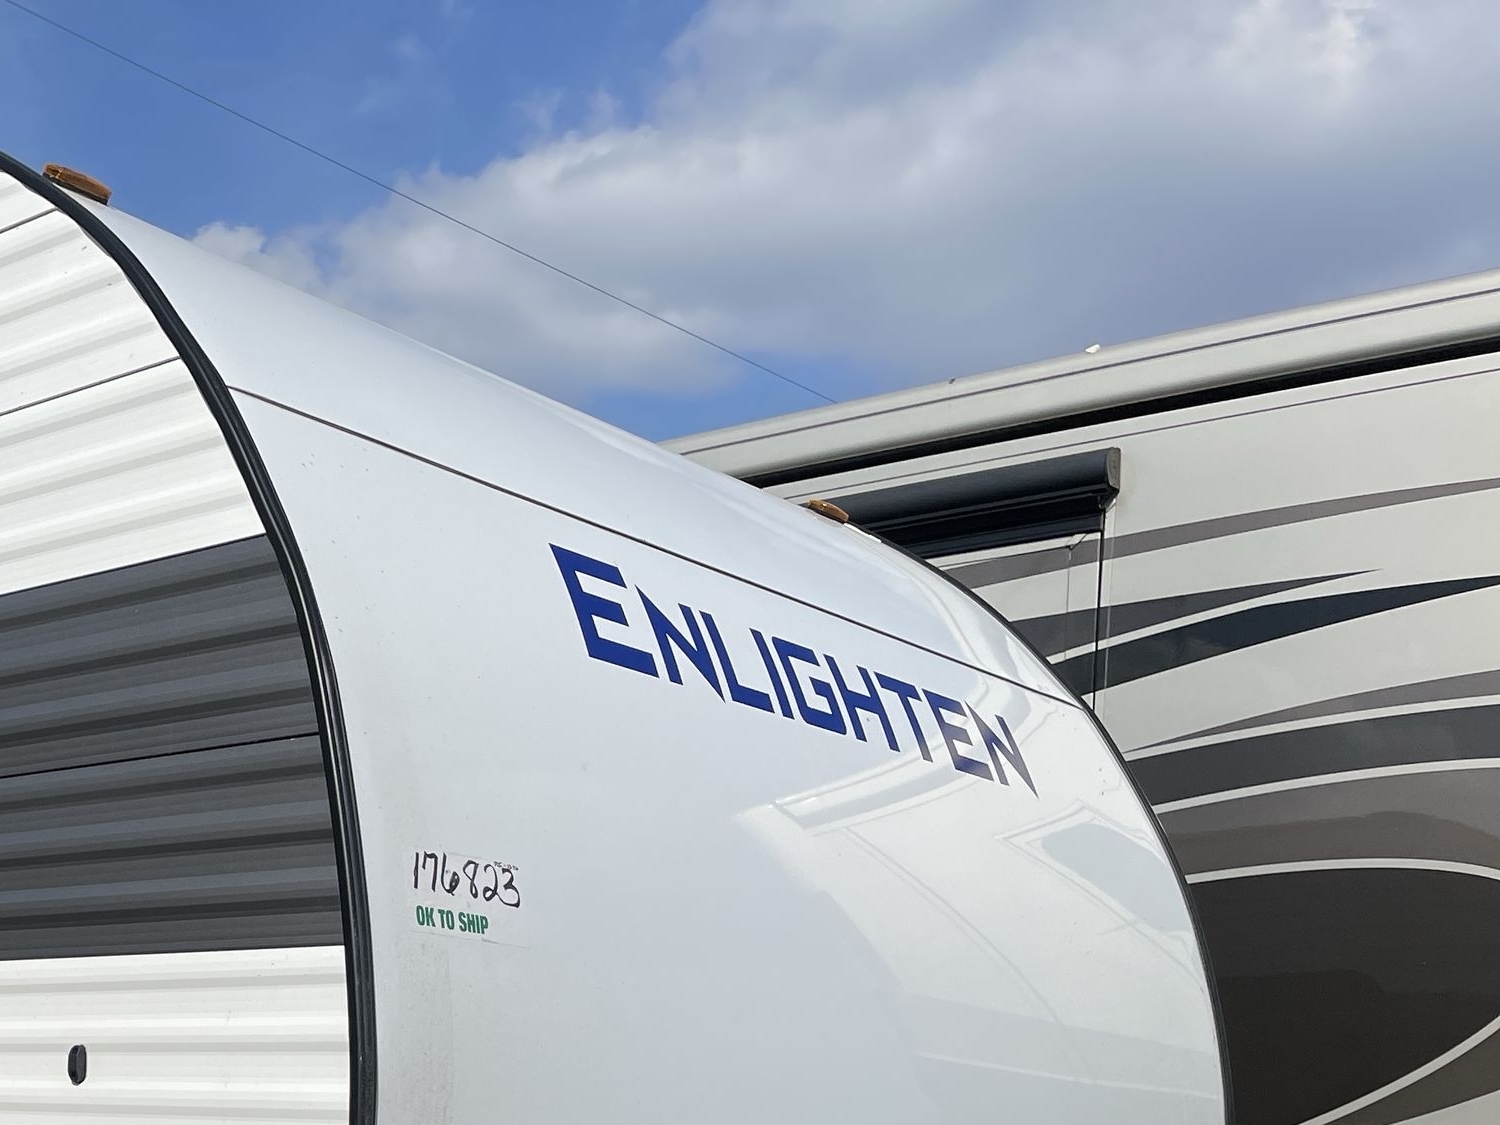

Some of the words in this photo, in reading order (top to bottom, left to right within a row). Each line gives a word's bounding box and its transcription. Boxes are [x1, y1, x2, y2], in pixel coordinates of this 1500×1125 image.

[548, 542, 1039, 800] ENLIGHTEN
[413, 850, 521, 908] 176823
[416, 905, 436, 928] OK
[437, 908, 455, 930] TO
[458, 911, 489, 935] SHIP
